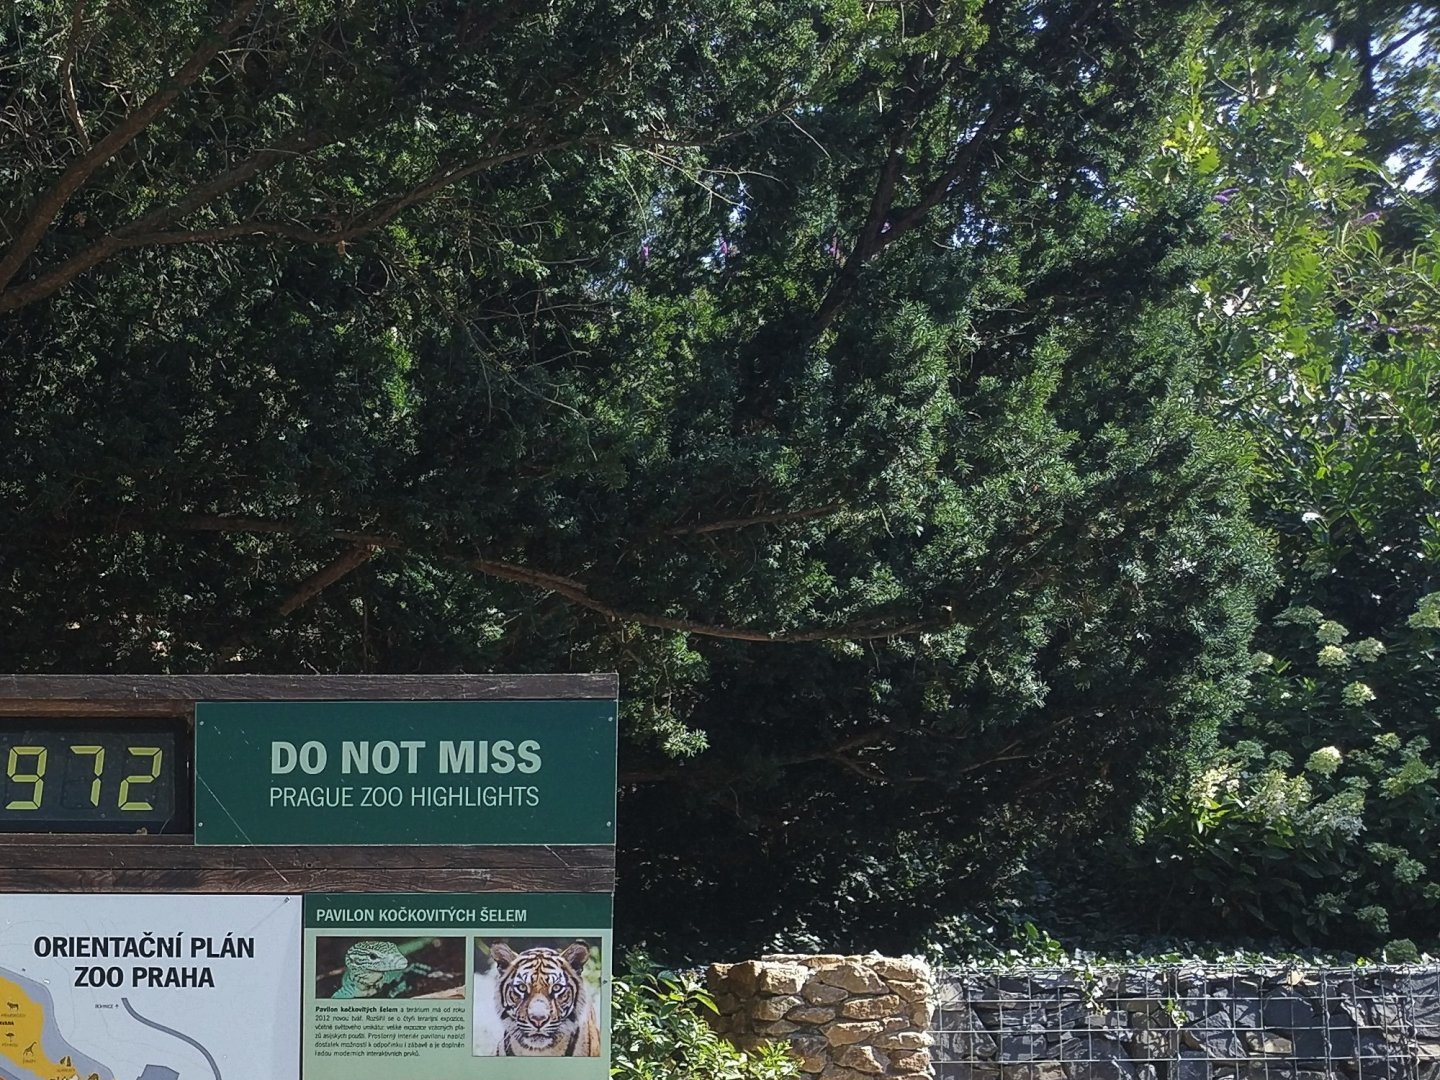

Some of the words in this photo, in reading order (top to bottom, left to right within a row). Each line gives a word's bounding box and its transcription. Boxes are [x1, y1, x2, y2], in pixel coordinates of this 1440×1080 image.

[271, 741, 328, 775] DO
[341, 741, 426, 775] NOT
[439, 740, 542, 775] MISS
[5, 745, 163, 811] 972
[270, 787, 354, 807] PRAGUE
[360, 787, 403, 807] ZOO
[411, 787, 540, 807] HIGHLIGHTS
[316, 909, 375, 922] PAVILON
[379, 906, 476, 922] KOČKOVITÝCH
[480, 906, 527, 922] ŠELEM
[34, 931, 184, 958] ORIENTAČNÍ
[190, 931, 255, 958] PLÁN
[74, 966, 124, 988] ZOO
[132, 967, 215, 988] PRAHA
[340, 1006, 377, 1014] kočkovitých
